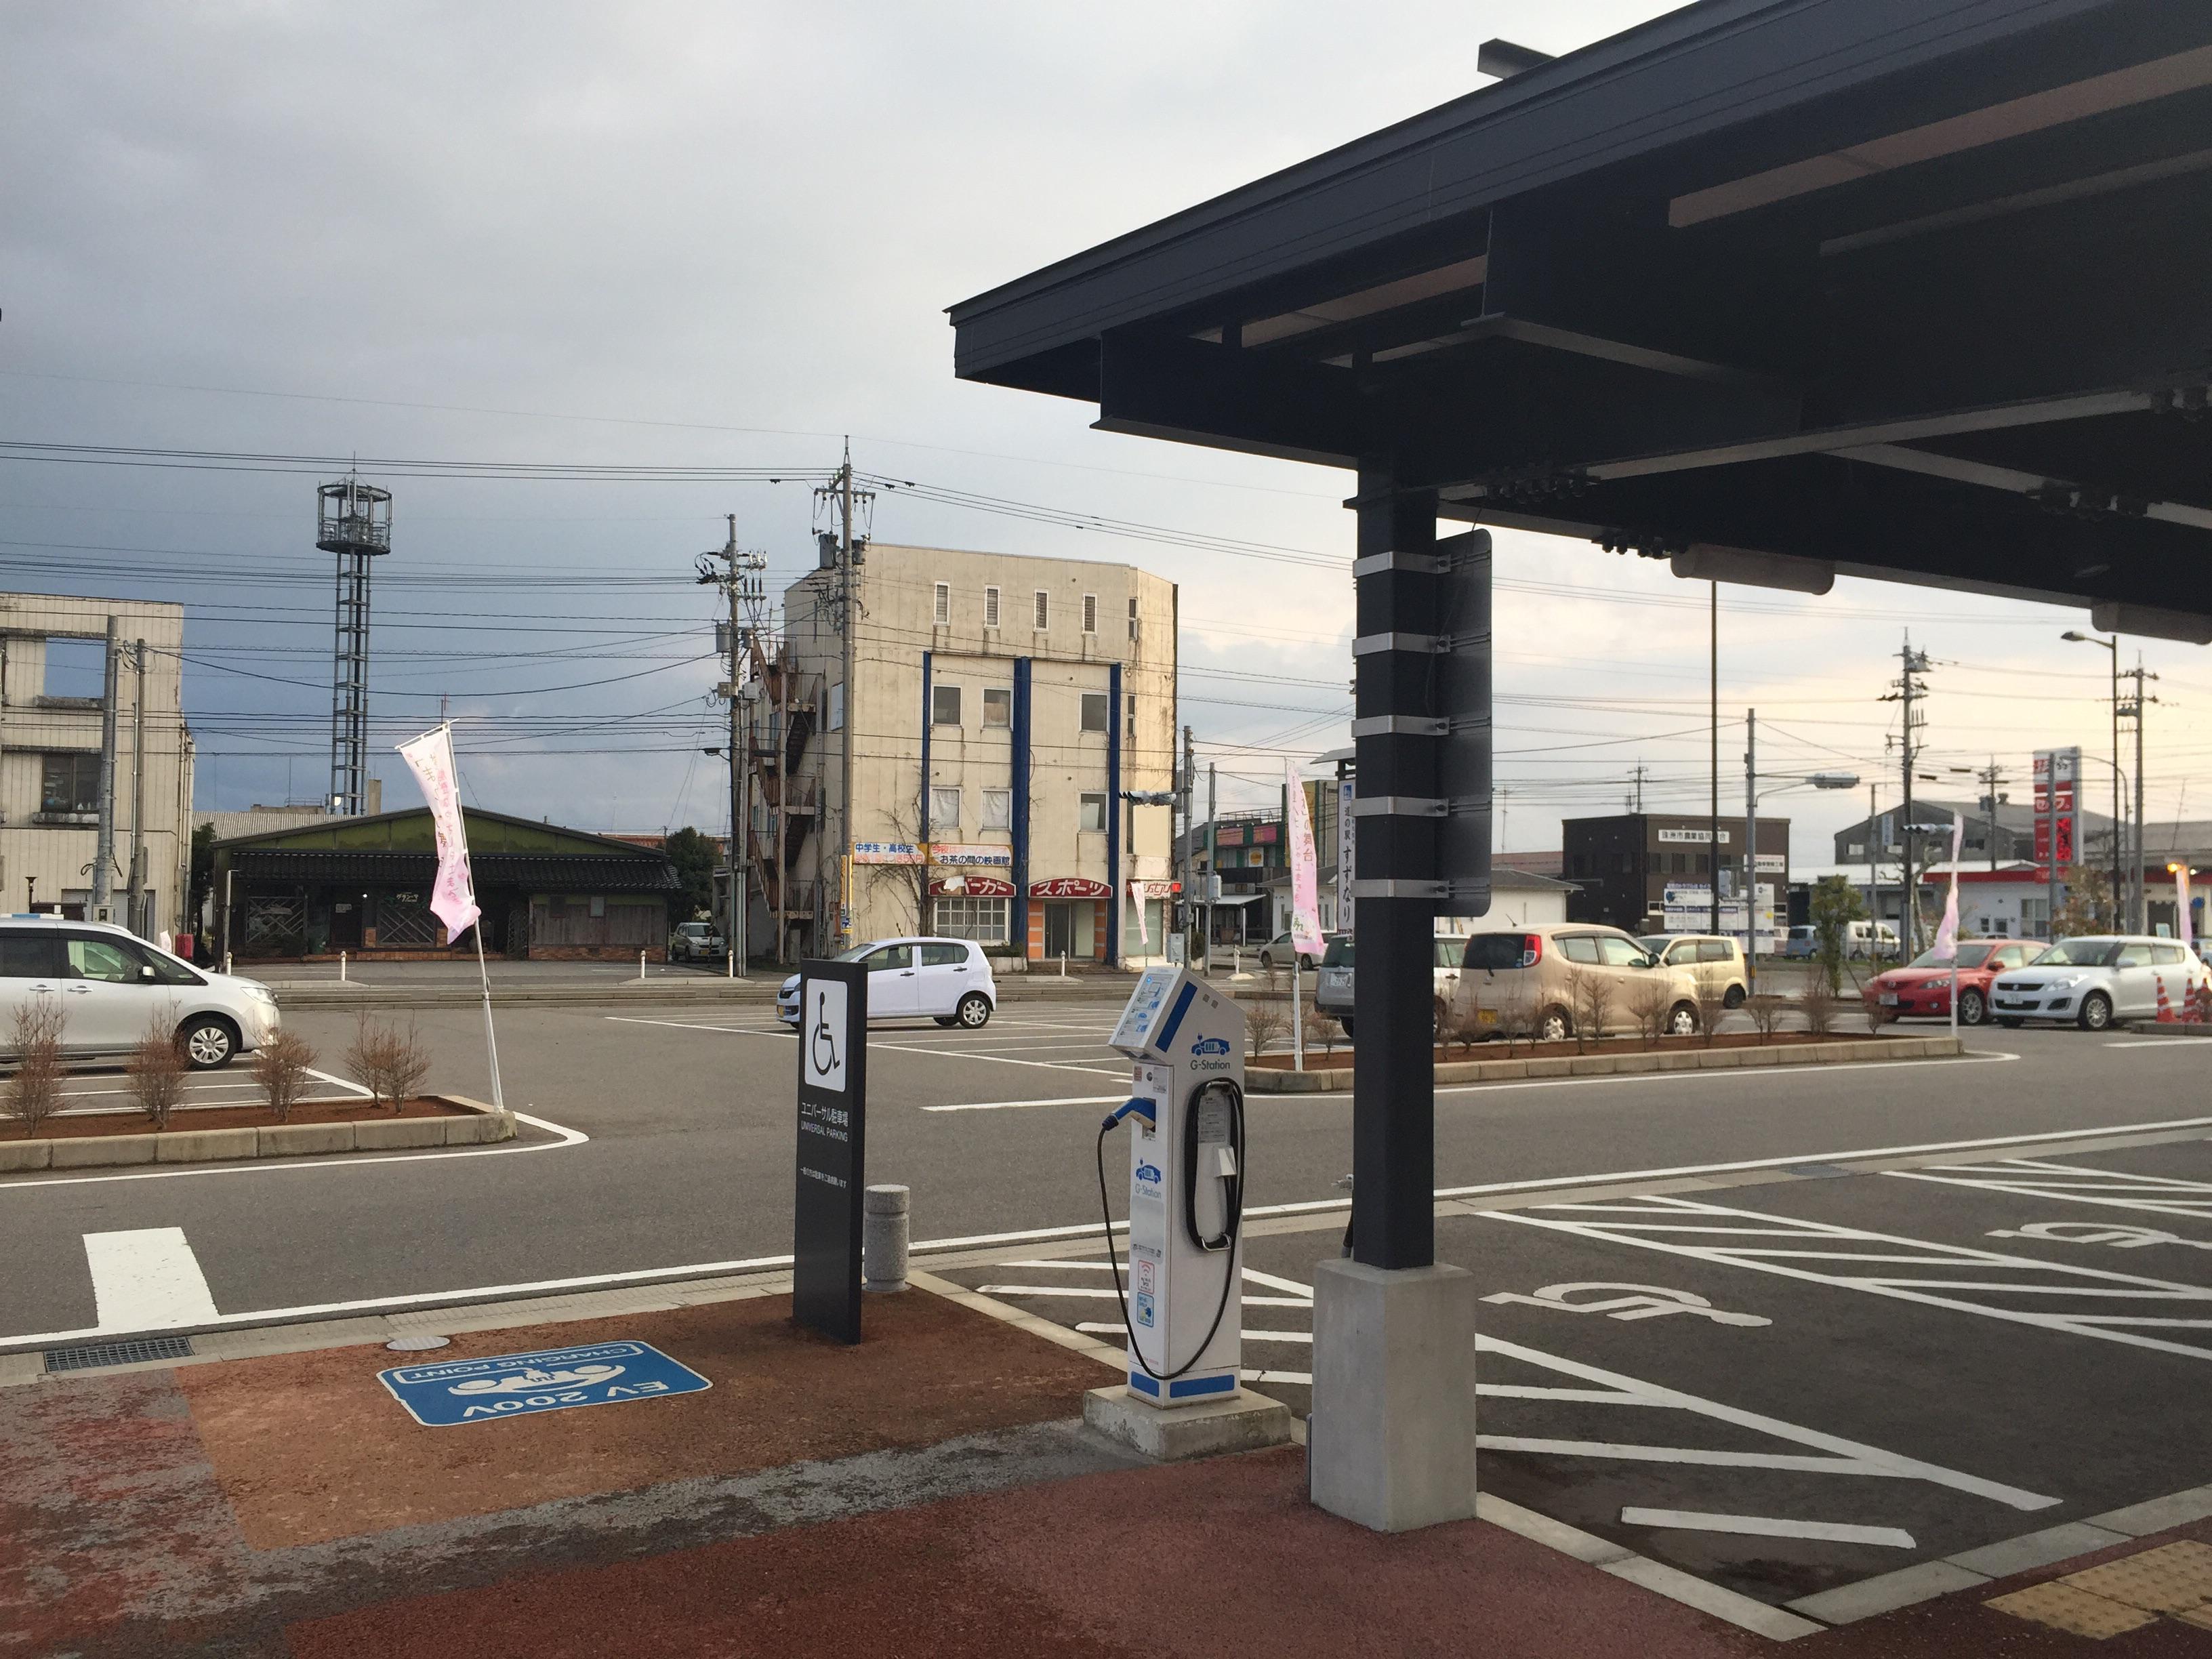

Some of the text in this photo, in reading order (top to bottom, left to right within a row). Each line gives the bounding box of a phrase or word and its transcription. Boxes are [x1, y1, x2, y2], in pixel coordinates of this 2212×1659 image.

[855, 843, 914, 853] 中学生・高校生
[940, 855, 1010, 865] お茶の間の映画館
[1036, 880, 1105, 896] スポーツ
[1343, 846, 1351, 922] すずなり
[1190, 1058, 1231, 1071] G-Station
[801, 1102, 848, 1127] ユニバーサル駐車場
[801, 1120, 848, 1142] UNIVERSAL PARKING
[1134, 1183, 1162, 1200] G-Station
[410, 1348, 628, 1379] CHARGING POINT
[462, 1381, 670, 1417] EV 200V
